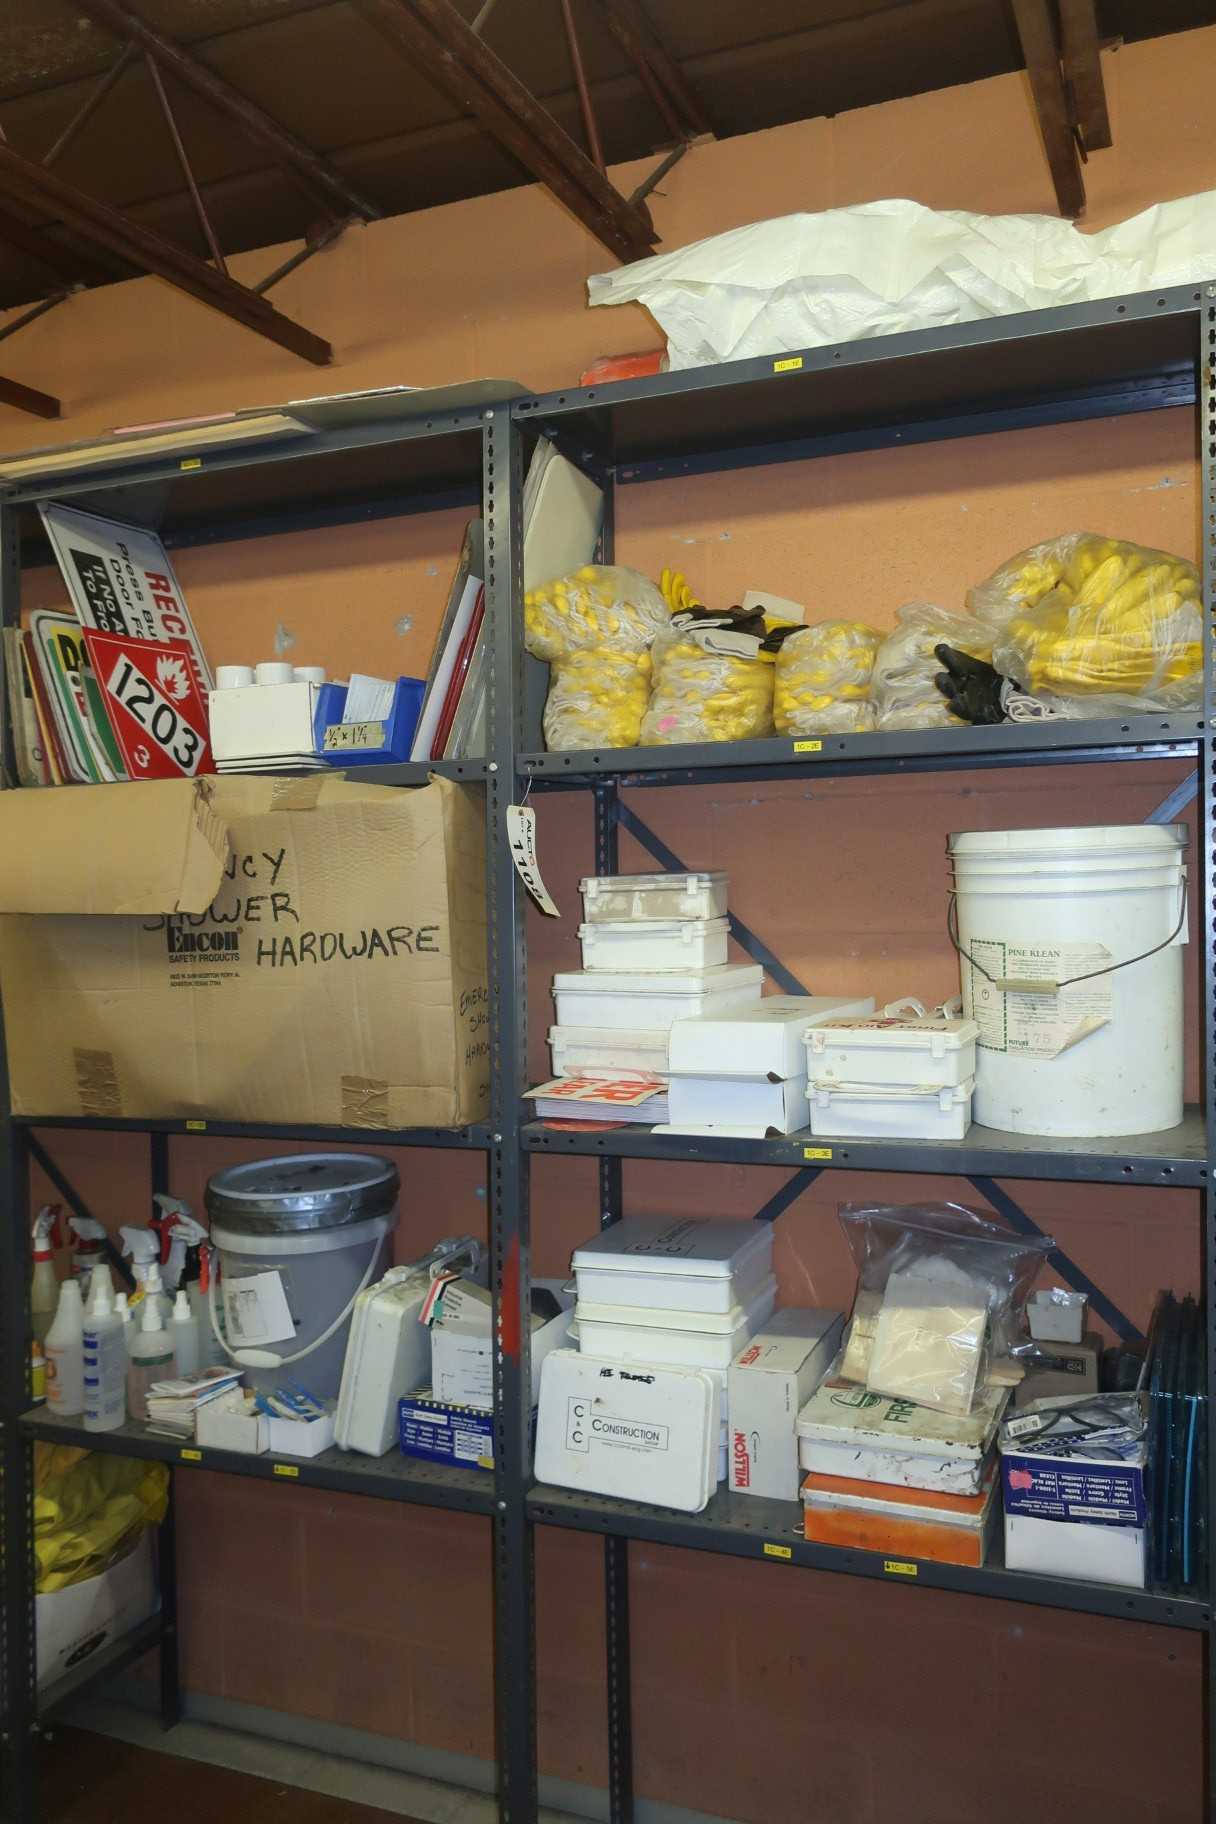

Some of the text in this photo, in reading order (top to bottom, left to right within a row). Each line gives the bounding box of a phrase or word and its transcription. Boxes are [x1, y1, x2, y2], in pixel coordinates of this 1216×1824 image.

[109, 558, 135, 611] Door
[116, 541, 144, 602] Press
[82, 570, 110, 632] To Fro
[101, 584, 116, 612] No
[115, 662, 199, 769] 1203
[133, 744, 150, 768] 3
[167, 927, 239, 953] Encon
[257, 925, 440, 967] HARDWARE
[1007, 948, 1061, 958] PINE KLEAN
[168, 952, 240, 964] SAFETY PRODUCTS
[574, 1405, 584, 1418] C
[572, 1431, 584, 1444] C
[591, 1418, 661, 1441] CONSTRUCTION
[733, 1432, 750, 1488] WILLSON
